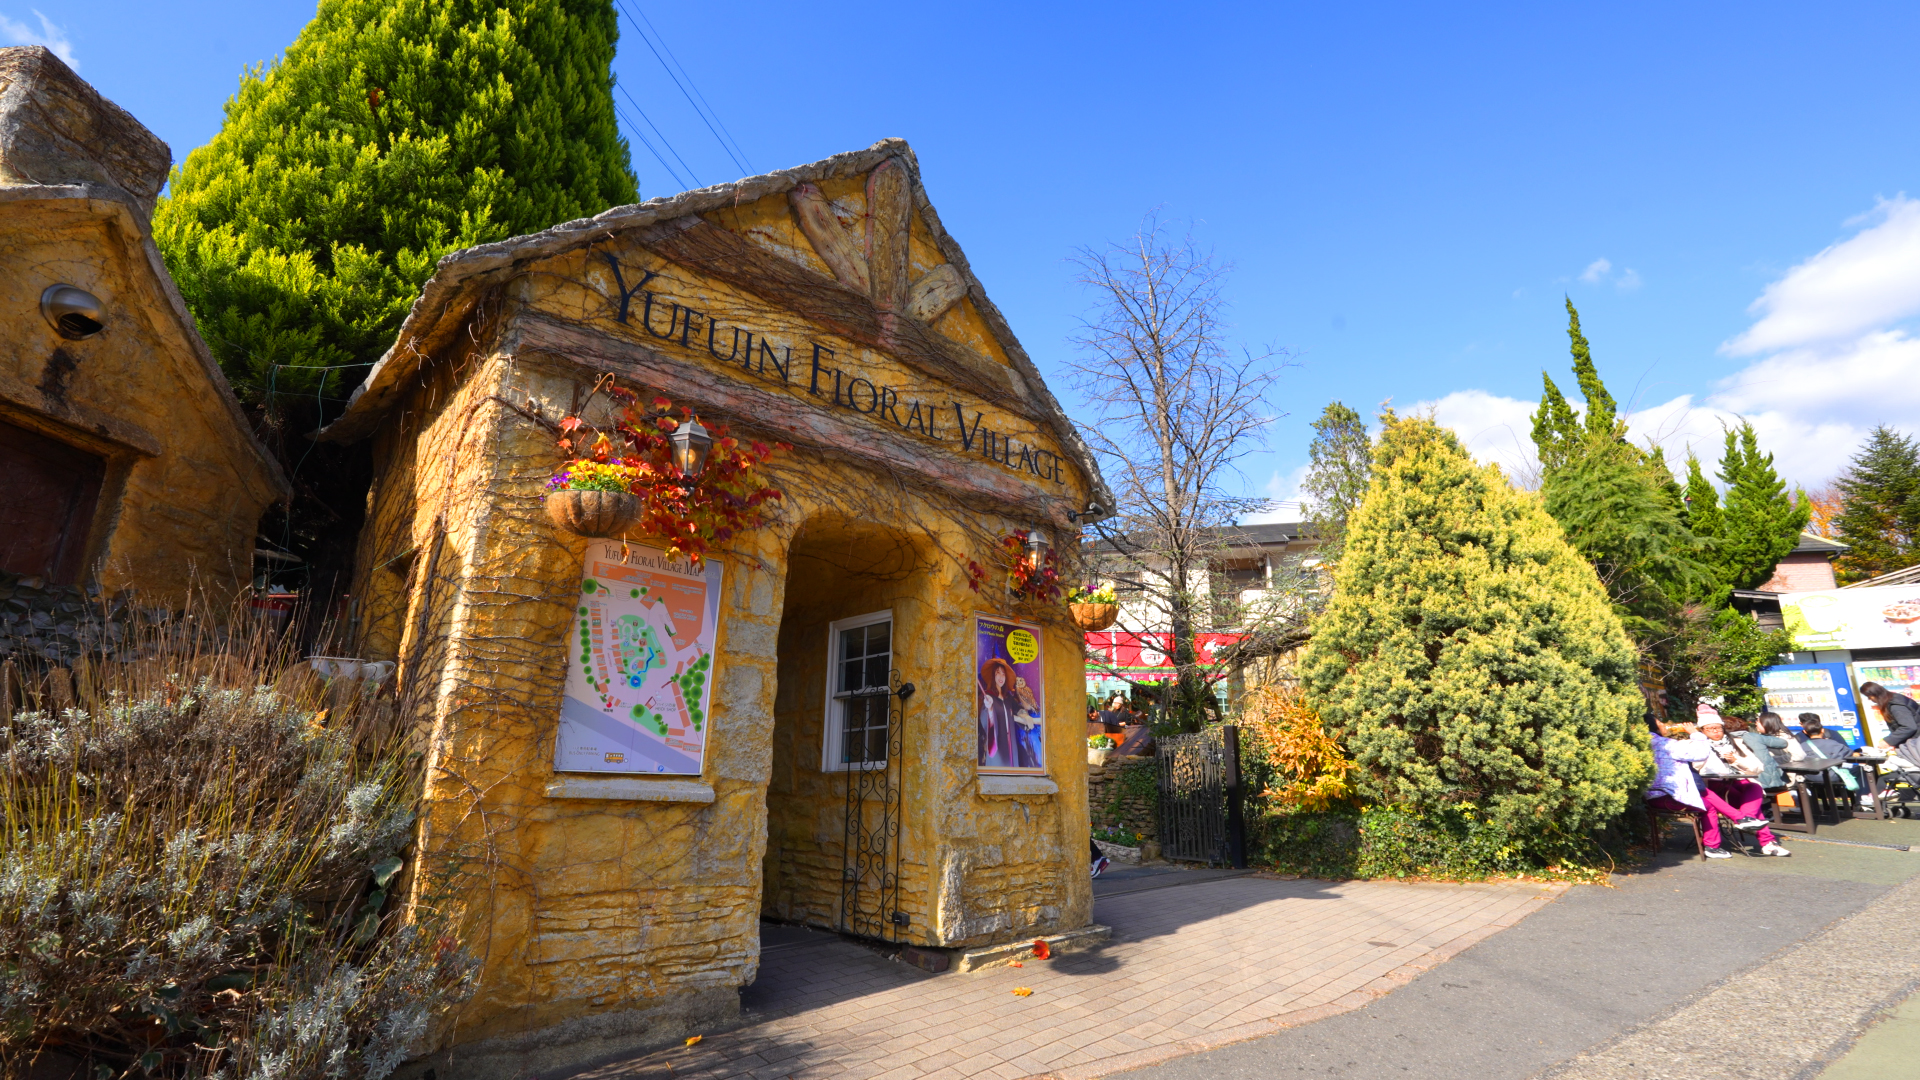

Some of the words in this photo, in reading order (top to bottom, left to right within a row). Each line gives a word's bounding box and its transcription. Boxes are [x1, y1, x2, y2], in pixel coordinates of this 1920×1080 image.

[604, 251, 791, 382] YUFUIN
[808, 341, 942, 440] FLORAL
[952, 401, 1065, 485] VILLAGE
[631, 551, 655, 568] FLORAL
[657, 556, 682, 573] VILLAGE
